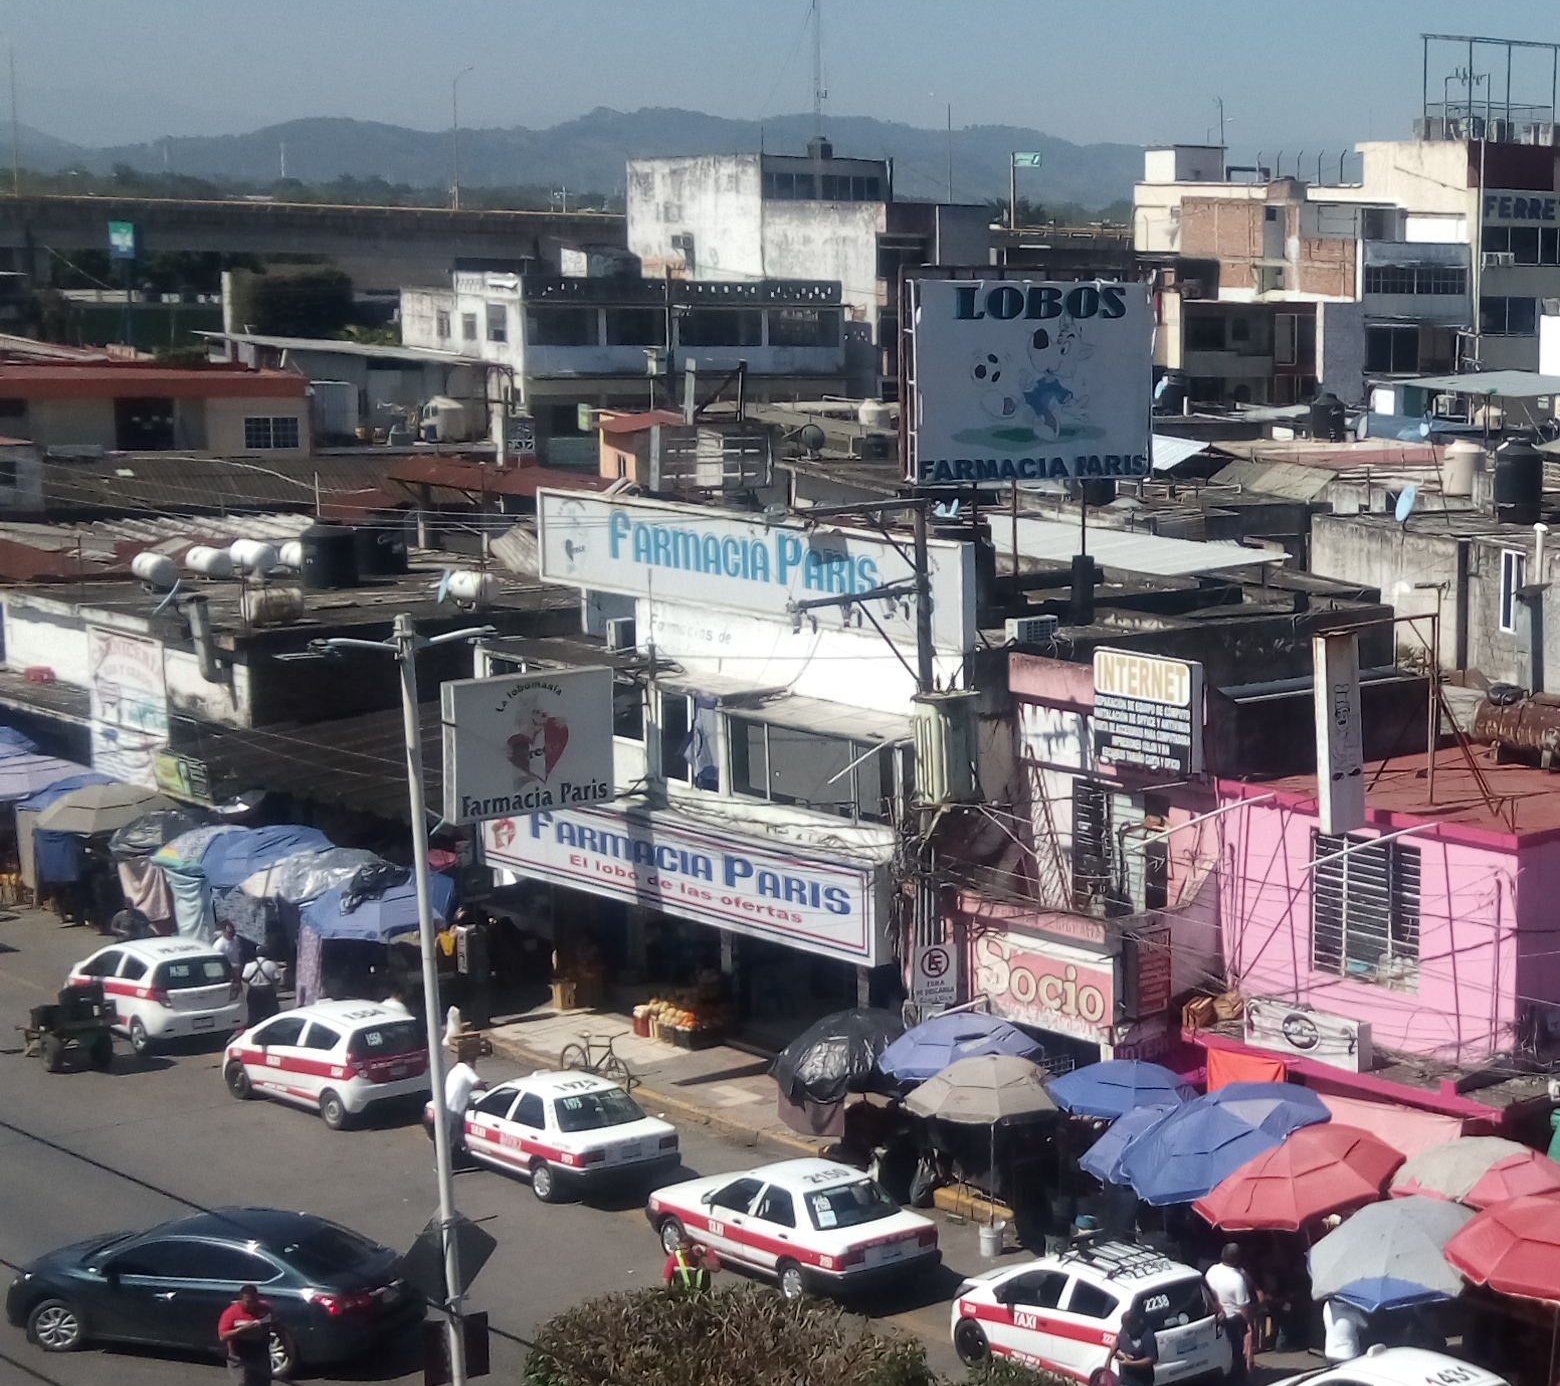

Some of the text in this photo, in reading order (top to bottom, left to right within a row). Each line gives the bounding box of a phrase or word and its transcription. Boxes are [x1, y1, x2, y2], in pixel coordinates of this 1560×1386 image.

[953, 286, 1127, 320] LOBOS
[918, 453, 1150, 481] FARMACIA PARIS
[608, 508, 879, 595] FARMACIA PARIS
[649, 613, 732, 645] Farmacias de
[1097, 652, 1187, 703] INTERNET
[496, 699, 508, 713] La
[461, 779, 608, 818] Farmacia Paris
[530, 812, 851, 915] FARMACIA PARIS
[569, 854, 803, 924] El lobo de las ofertas
[975, 934, 1106, 1023] Socio
[553, 1079, 598, 1092] 1975
[803, 1168, 850, 1184] 2150
[1143, 1294, 1170, 1312] 2238
[1013, 1312, 1037, 1329] TAXI
